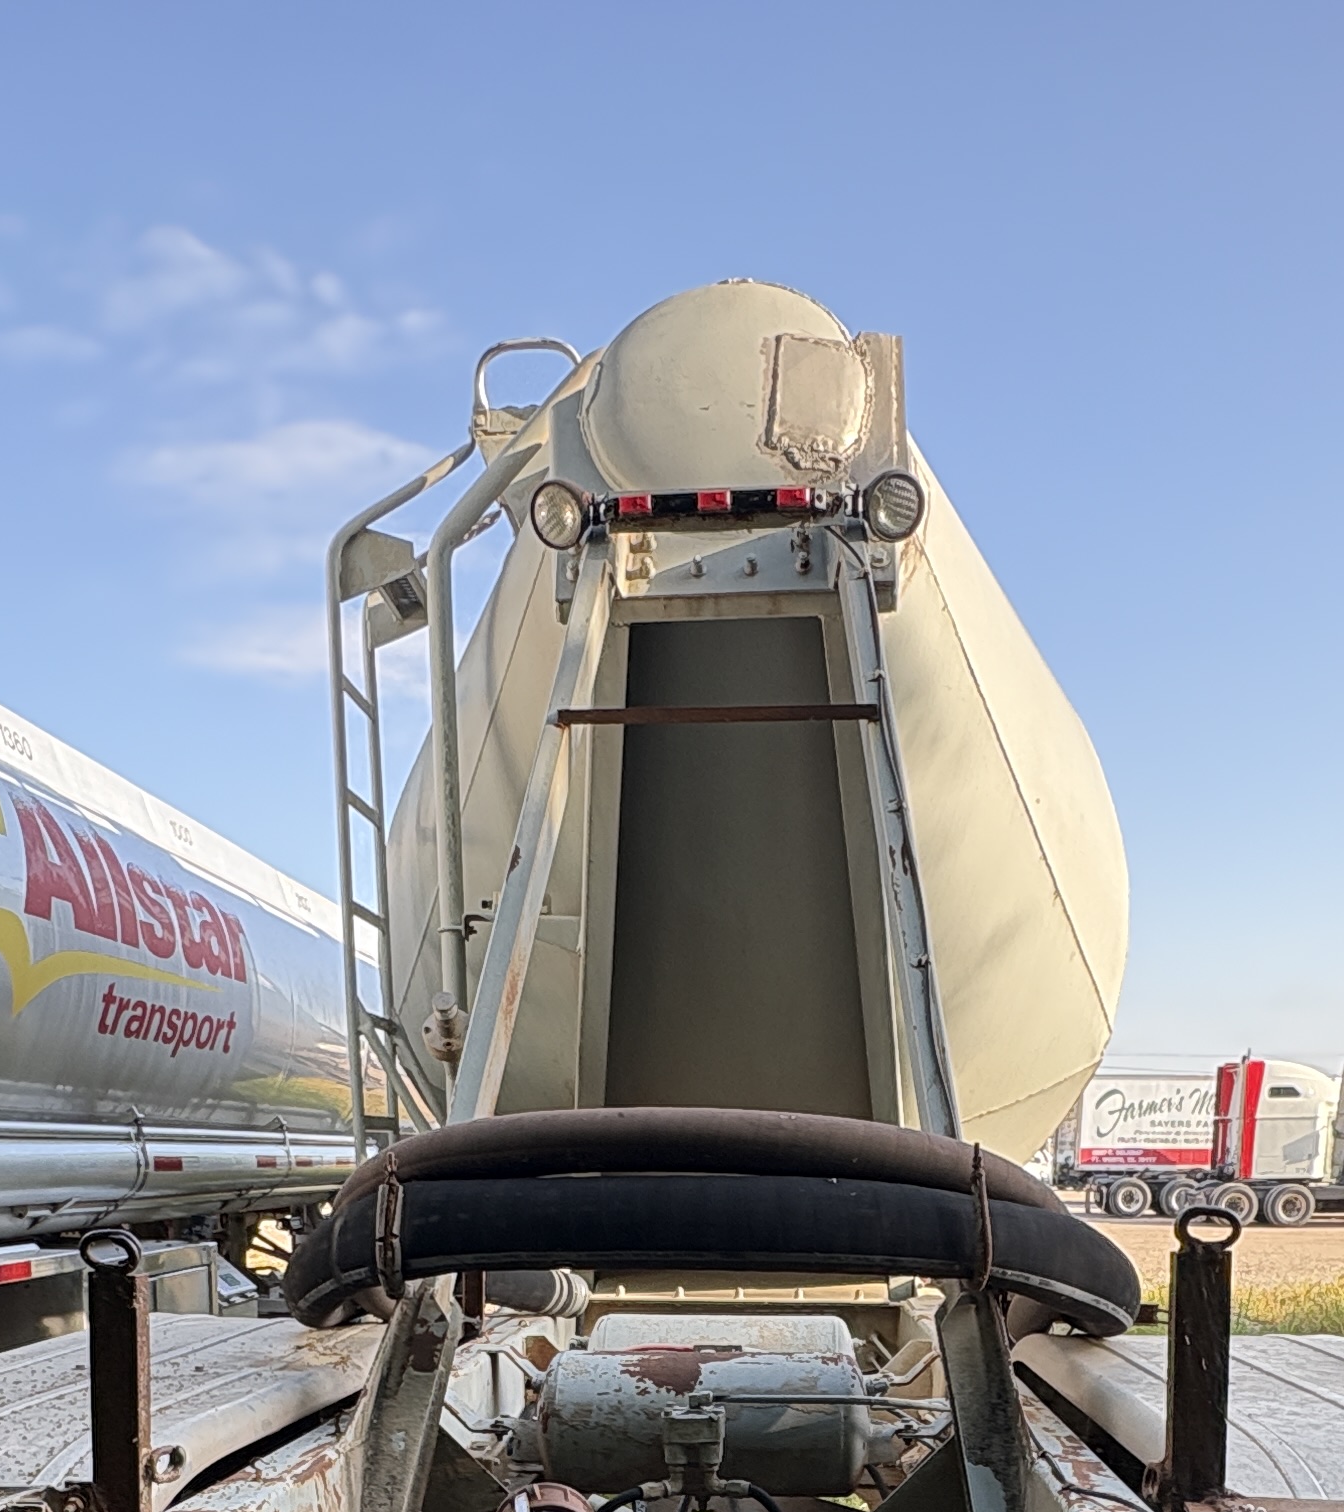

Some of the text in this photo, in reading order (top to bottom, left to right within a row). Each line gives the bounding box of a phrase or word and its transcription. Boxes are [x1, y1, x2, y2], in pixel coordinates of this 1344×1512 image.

[8, 790, 247, 984] Allstar
[97, 982, 237, 1058] transport
[1095, 1088, 1185, 1138] Farmer's
